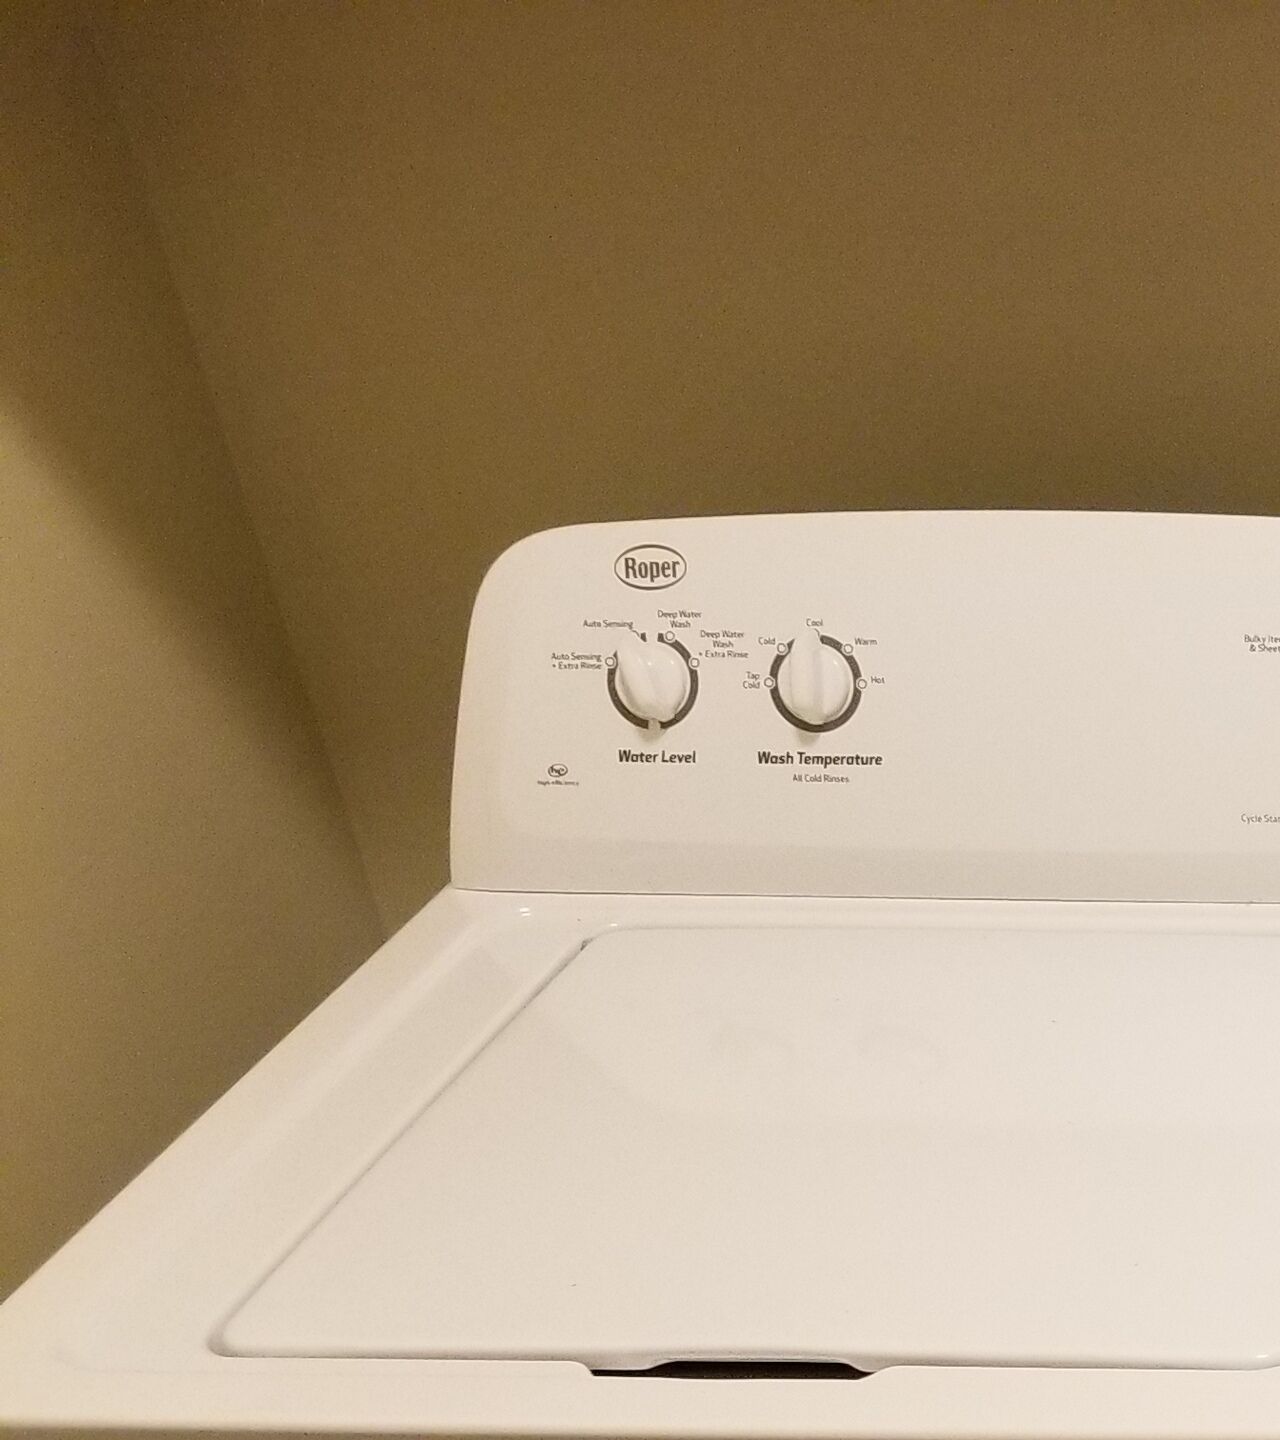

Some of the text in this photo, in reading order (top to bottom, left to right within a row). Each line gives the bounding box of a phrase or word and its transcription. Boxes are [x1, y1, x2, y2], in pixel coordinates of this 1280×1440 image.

[625, 557, 681, 582] Roper
[657, 609, 702, 619] Deep Water
[583, 619, 633, 630] Auto Sensing
[670, 620, 691, 628] Wash
[806, 618, 823, 627] Cool
[700, 629, 744, 639] Deep Water
[713, 639, 734, 648] Wash
[758, 636, 776, 645] Cold
[854, 637, 878, 646] Warm
[1244, 635, 1266, 645] Bulky
[552, 652, 602, 662] Auto Sensing
[705, 649, 725, 658] Extra
[727, 650, 749, 658] Rinse
[558, 661, 578, 669] Extra
[580, 661, 602, 669] Rinse
[747, 671, 760, 681] Tap
[870, 676, 885, 684] Hot
[742, 680, 760, 689] Cold
[618, 750, 696, 763] Water Level
[757, 751, 883, 769] Wash Temperature
[792, 774, 850, 783] All Cold Rinses
[1241, 814, 1262, 824] Cycle
